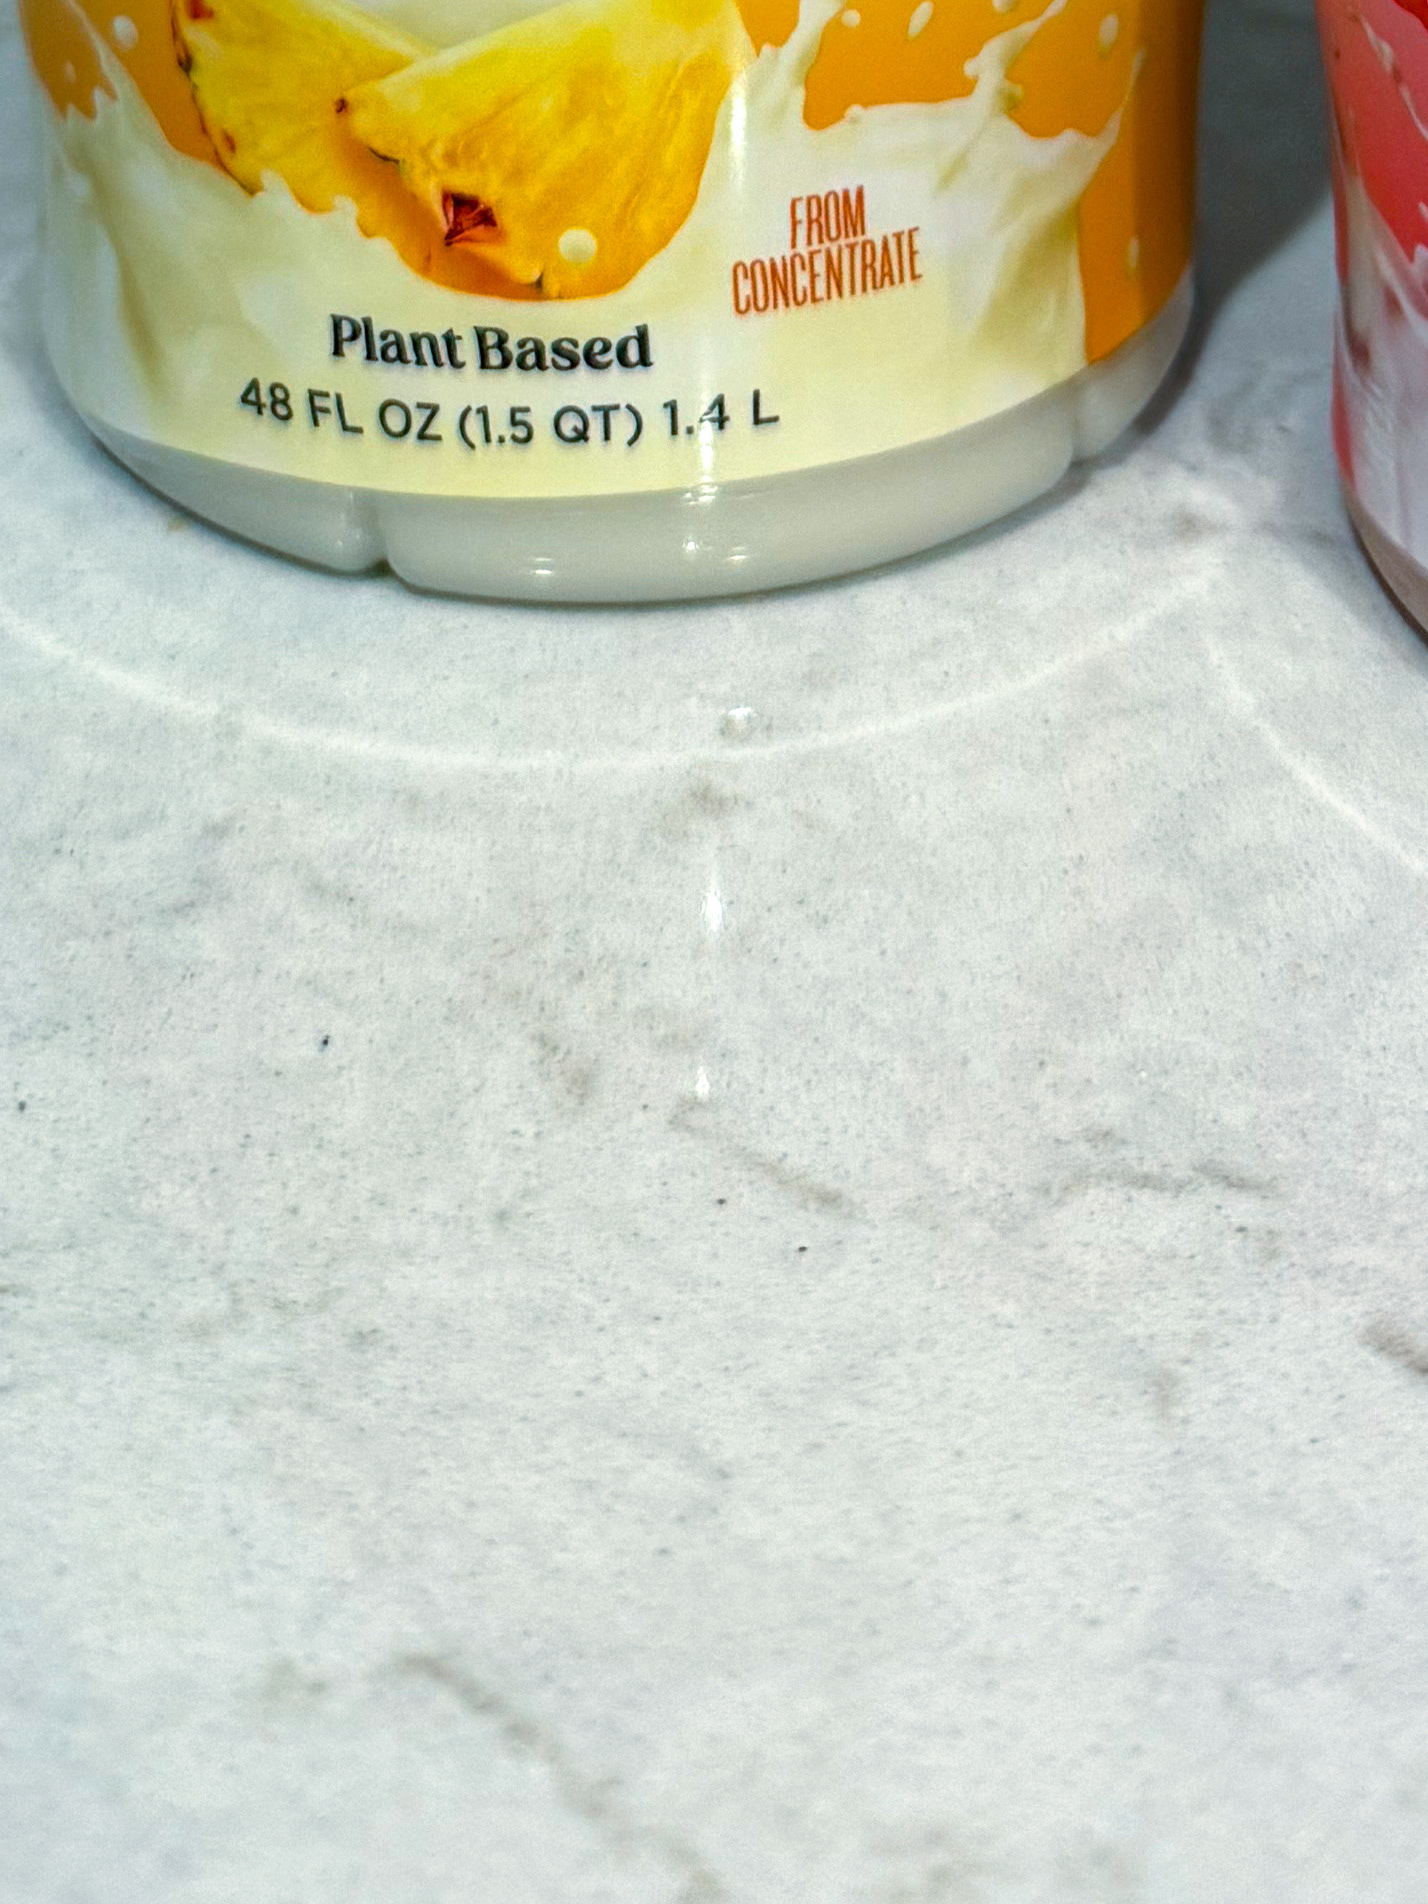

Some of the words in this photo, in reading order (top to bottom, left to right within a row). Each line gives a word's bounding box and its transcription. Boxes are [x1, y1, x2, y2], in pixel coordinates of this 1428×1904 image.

[789, 185, 867, 251] FROM
[731, 227, 924, 316] CONCENTRATE
[330, 313, 466, 370] Plant
[474, 323, 654, 373] Based
[240, 376, 292, 421] 48
[307, 390, 364, 436] FL
[378, 398, 444, 443] OZ
[459, 406, 534, 451] (1.5
[552, 402, 645, 448] QT)
[664, 395, 730, 439] 1.4
[752, 388, 780, 426] L
